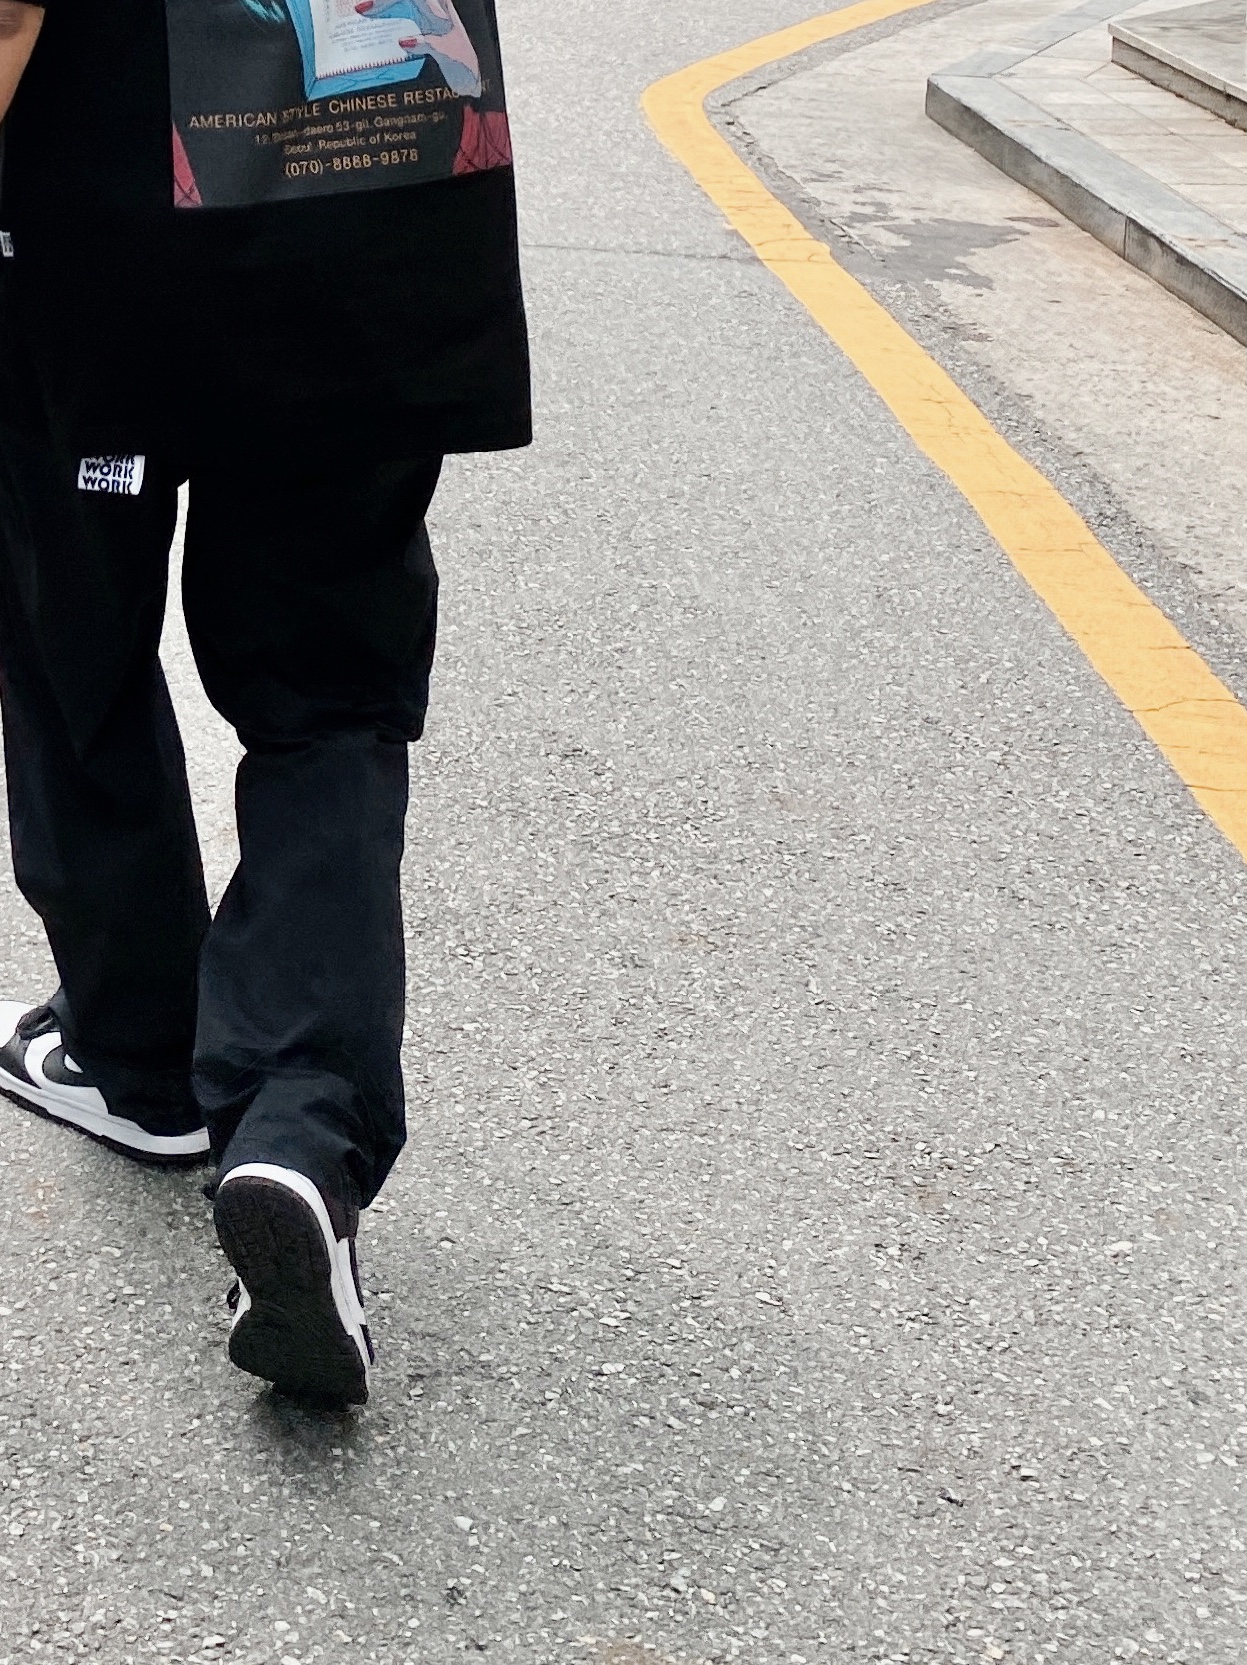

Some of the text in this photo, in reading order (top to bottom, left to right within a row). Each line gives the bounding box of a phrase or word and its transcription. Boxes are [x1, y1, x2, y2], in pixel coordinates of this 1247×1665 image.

[189, 112, 277, 129] AMERICAN
[328, 93, 397, 114] CHINESE
[369, 133, 381, 145] of
[384, 129, 417, 143] Korea
[85, 459, 134, 480] WORK
